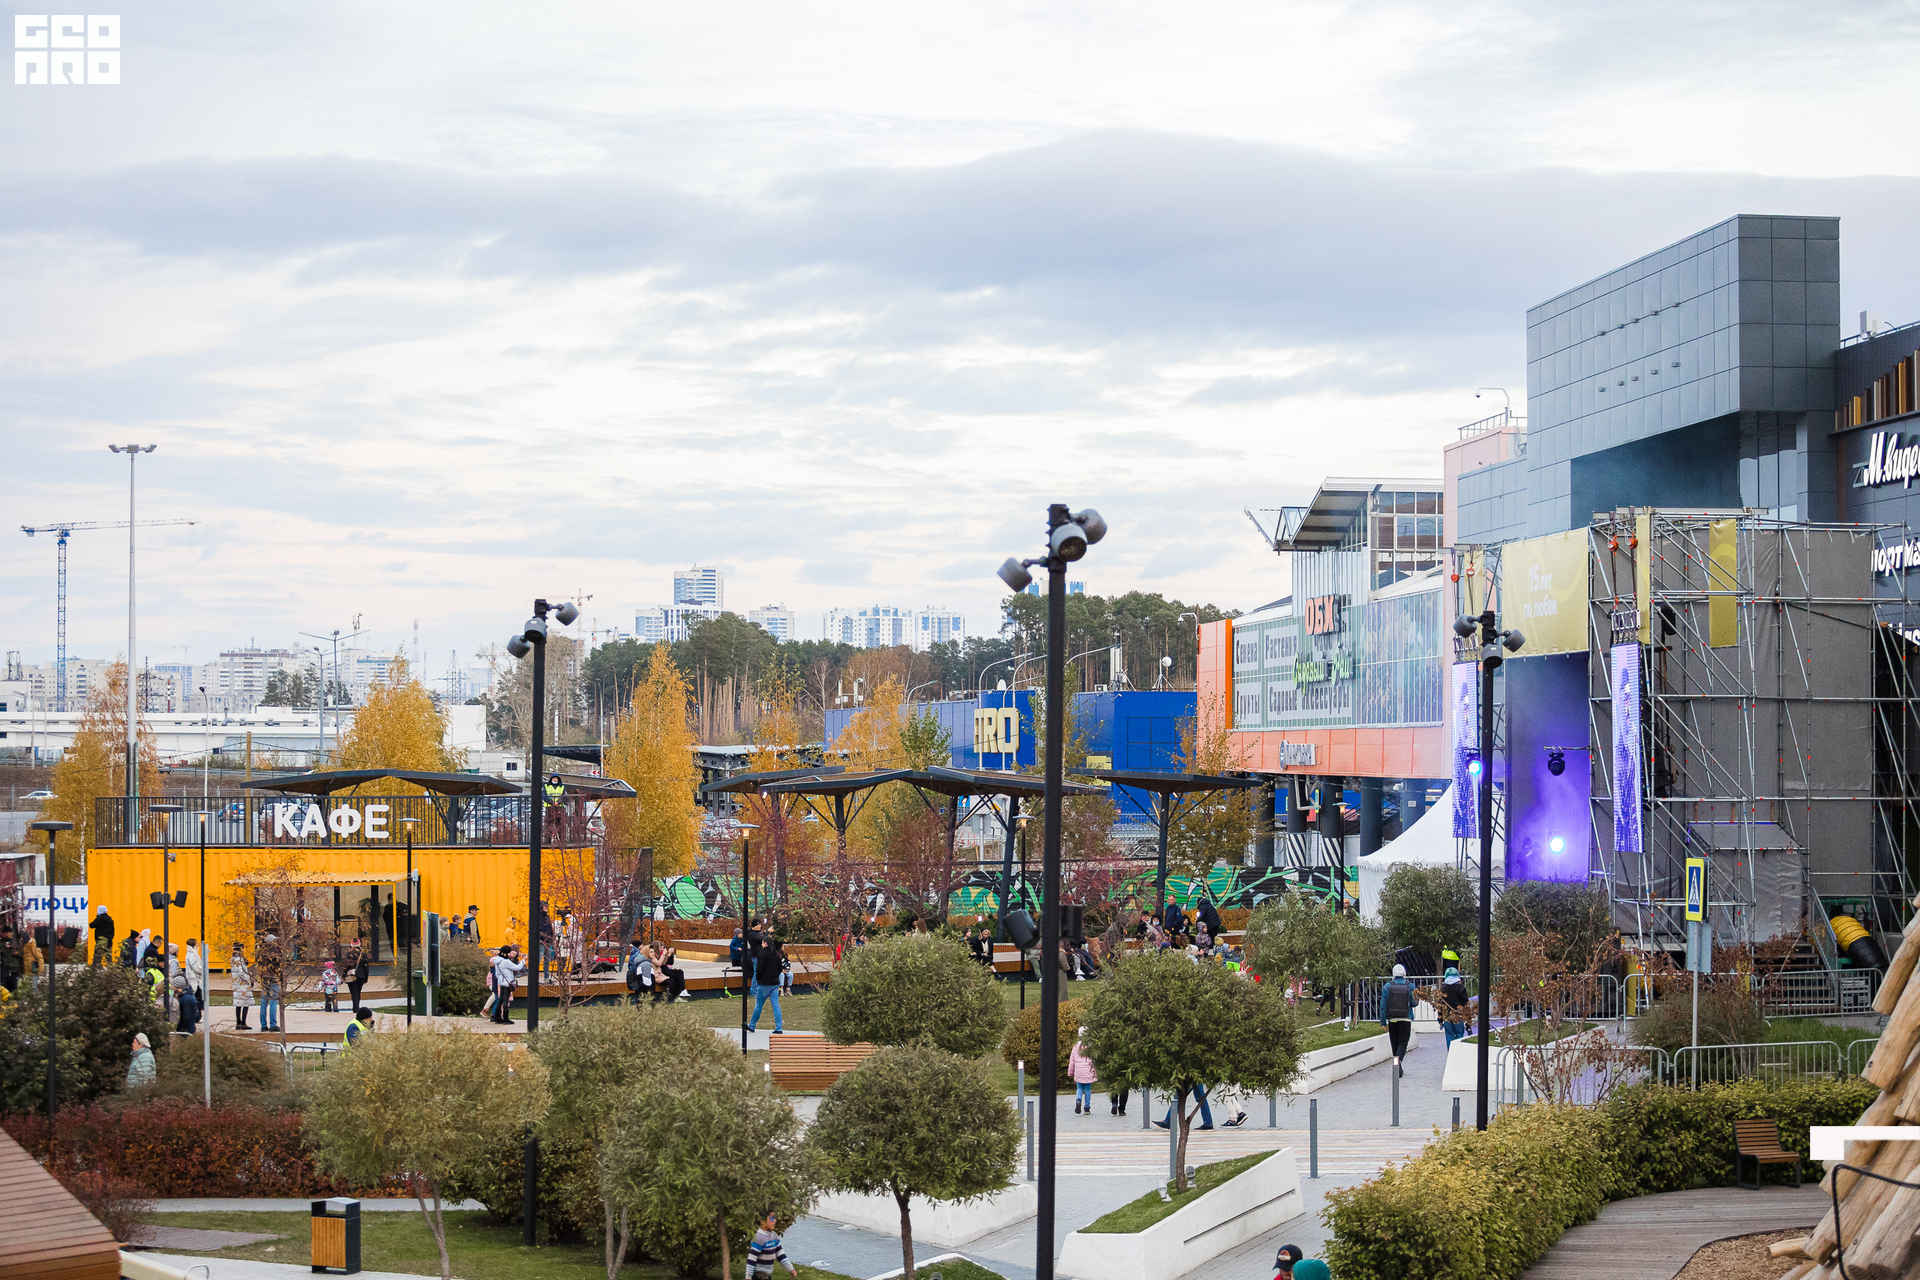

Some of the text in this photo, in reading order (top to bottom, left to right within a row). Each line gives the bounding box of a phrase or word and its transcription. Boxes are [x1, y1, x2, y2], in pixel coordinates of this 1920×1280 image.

[1863, 431, 1920, 490] М.виде
[1529, 564, 1552, 592] 15 лет
[1523, 594, 1558, 618] по любви
[274, 803, 390, 839] КАФЕ
